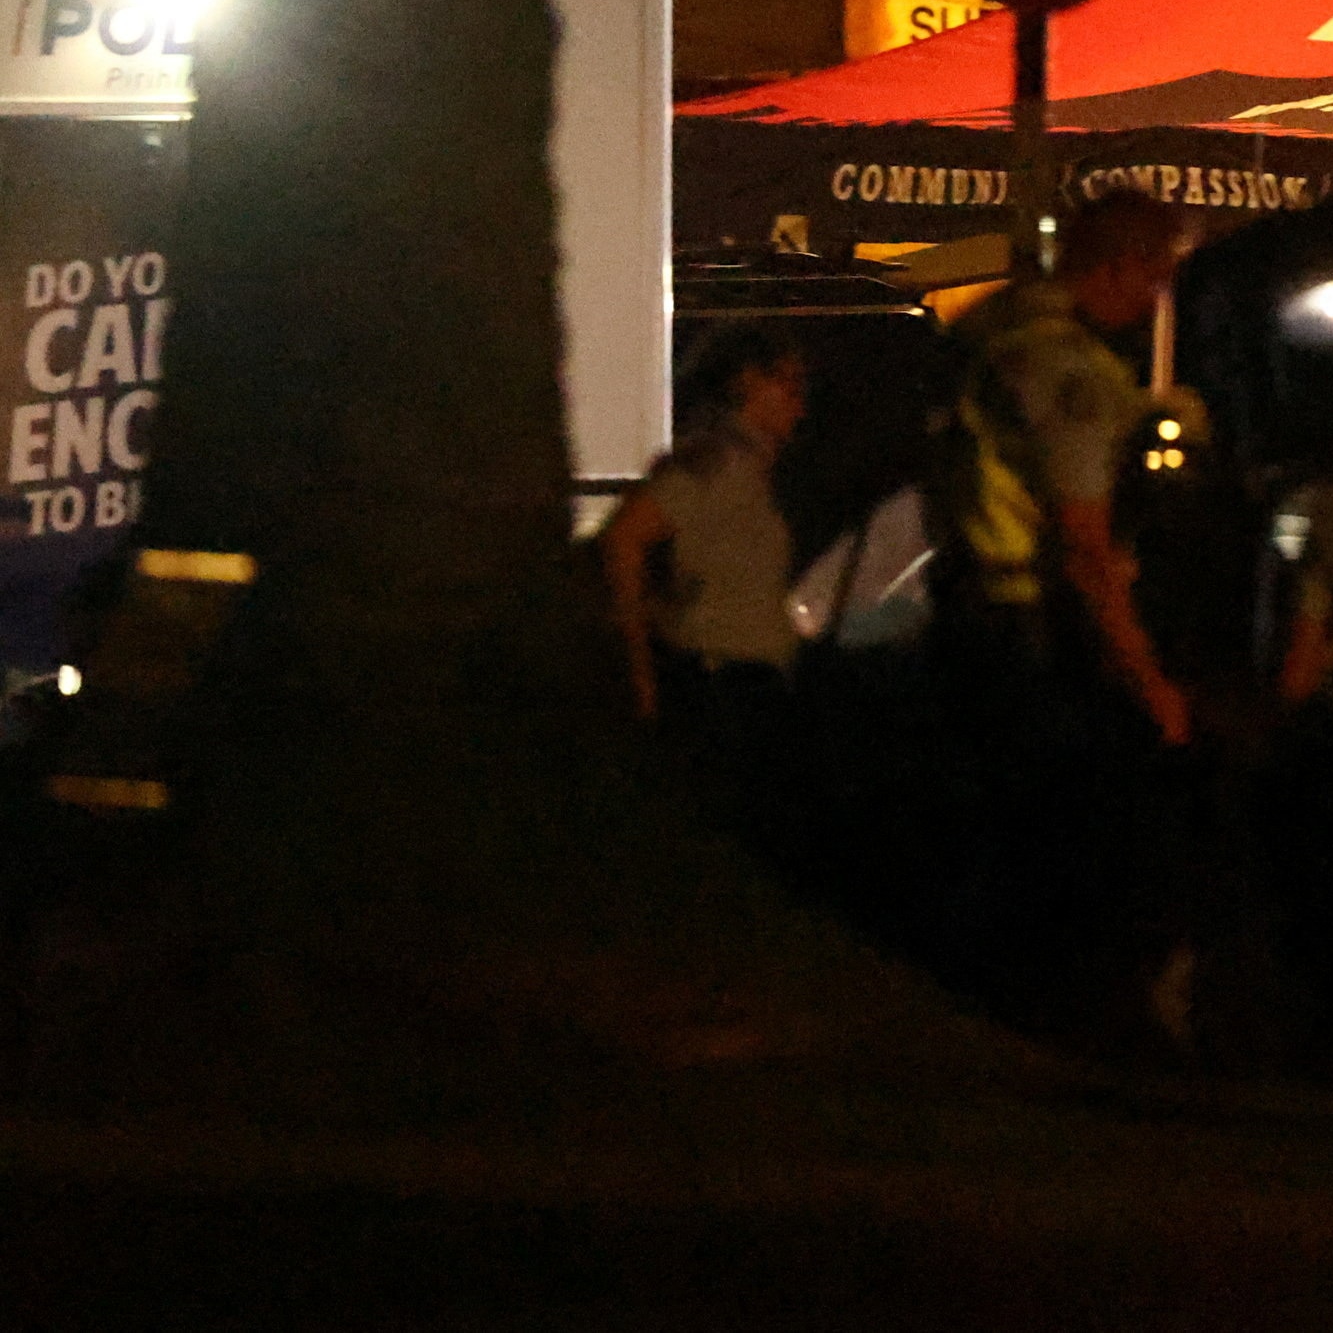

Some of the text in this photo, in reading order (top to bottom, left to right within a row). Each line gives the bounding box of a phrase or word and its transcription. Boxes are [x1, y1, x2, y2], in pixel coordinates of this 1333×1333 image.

[830, 162, 1009, 206] COMMUNI
[26, 251, 166, 308] DO YO
[25, 485, 87, 536] TO
